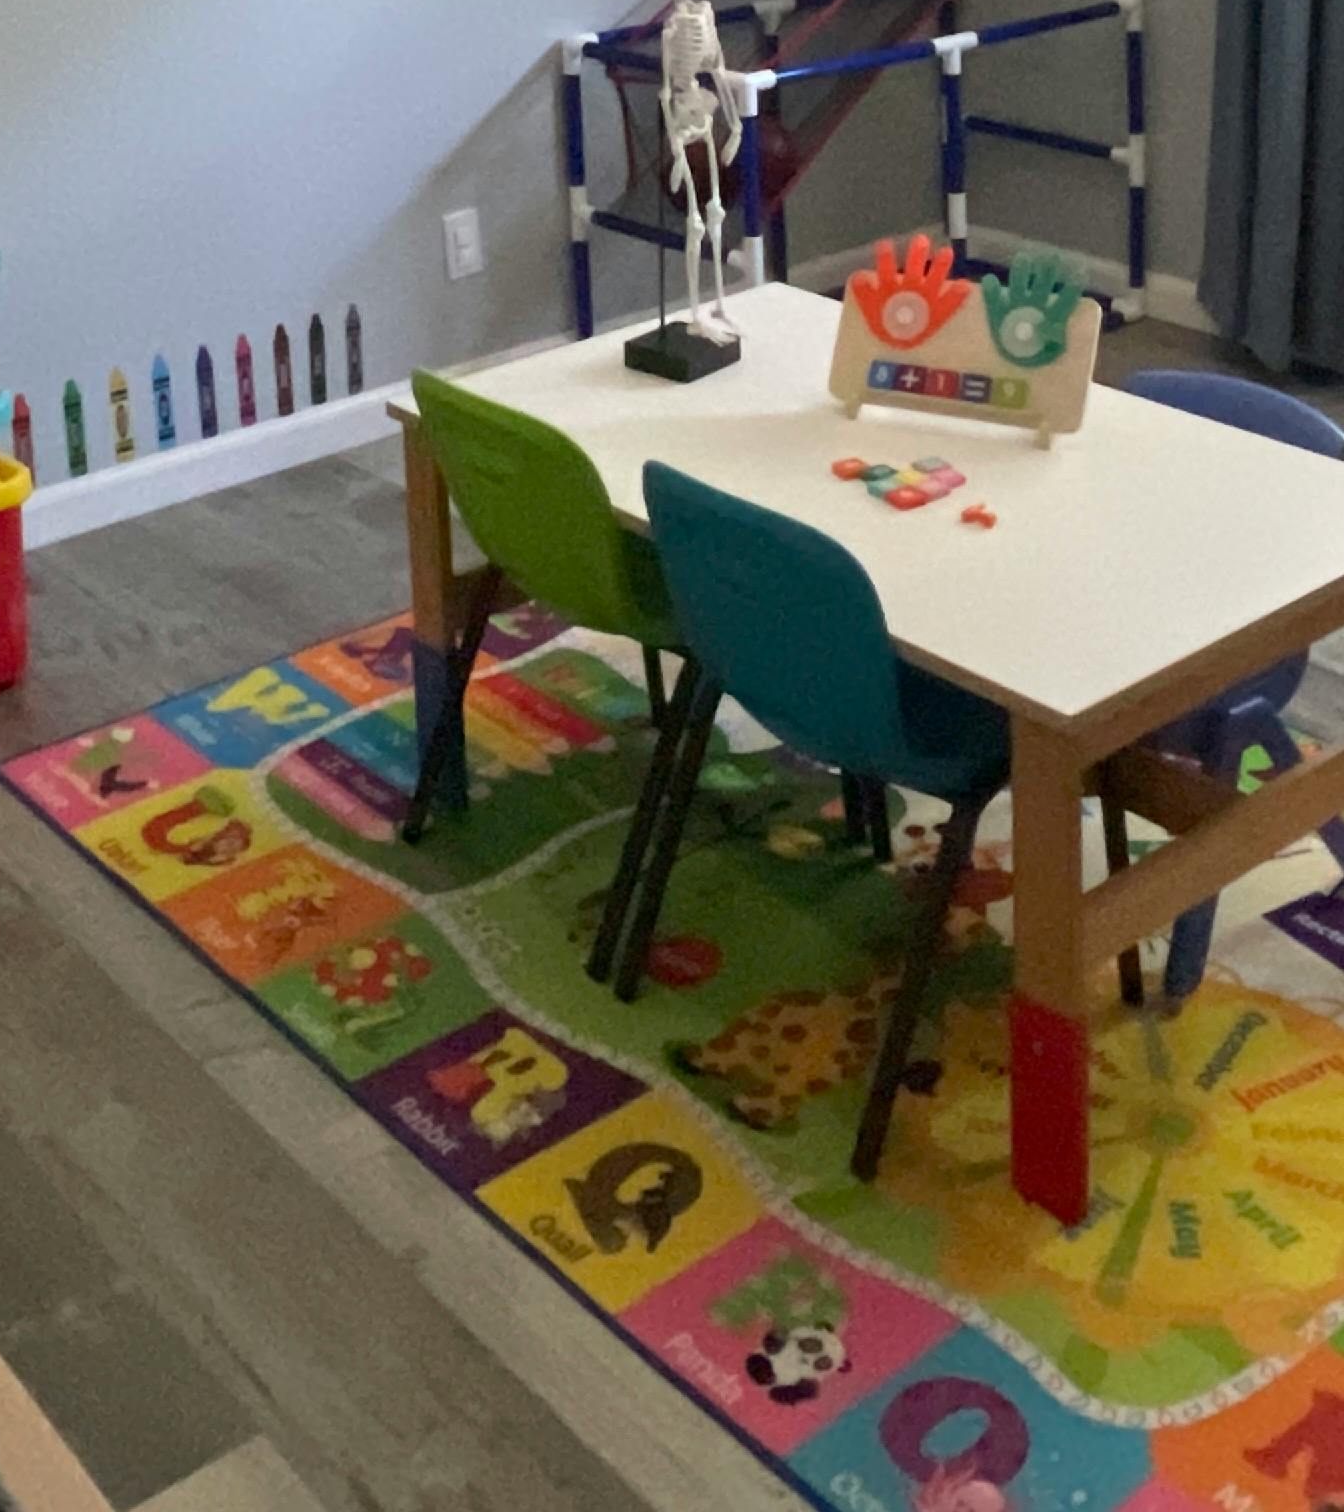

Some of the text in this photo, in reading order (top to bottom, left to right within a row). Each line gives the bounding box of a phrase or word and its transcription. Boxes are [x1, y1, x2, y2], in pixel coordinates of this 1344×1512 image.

[391, 1095, 461, 1157] Rabbit
[529, 1213, 594, 1264] Quail
[1167, 1201, 1203, 1259] May
[1223, 1189, 1303, 1251] April
[662, 1331, 744, 1404] Panda
